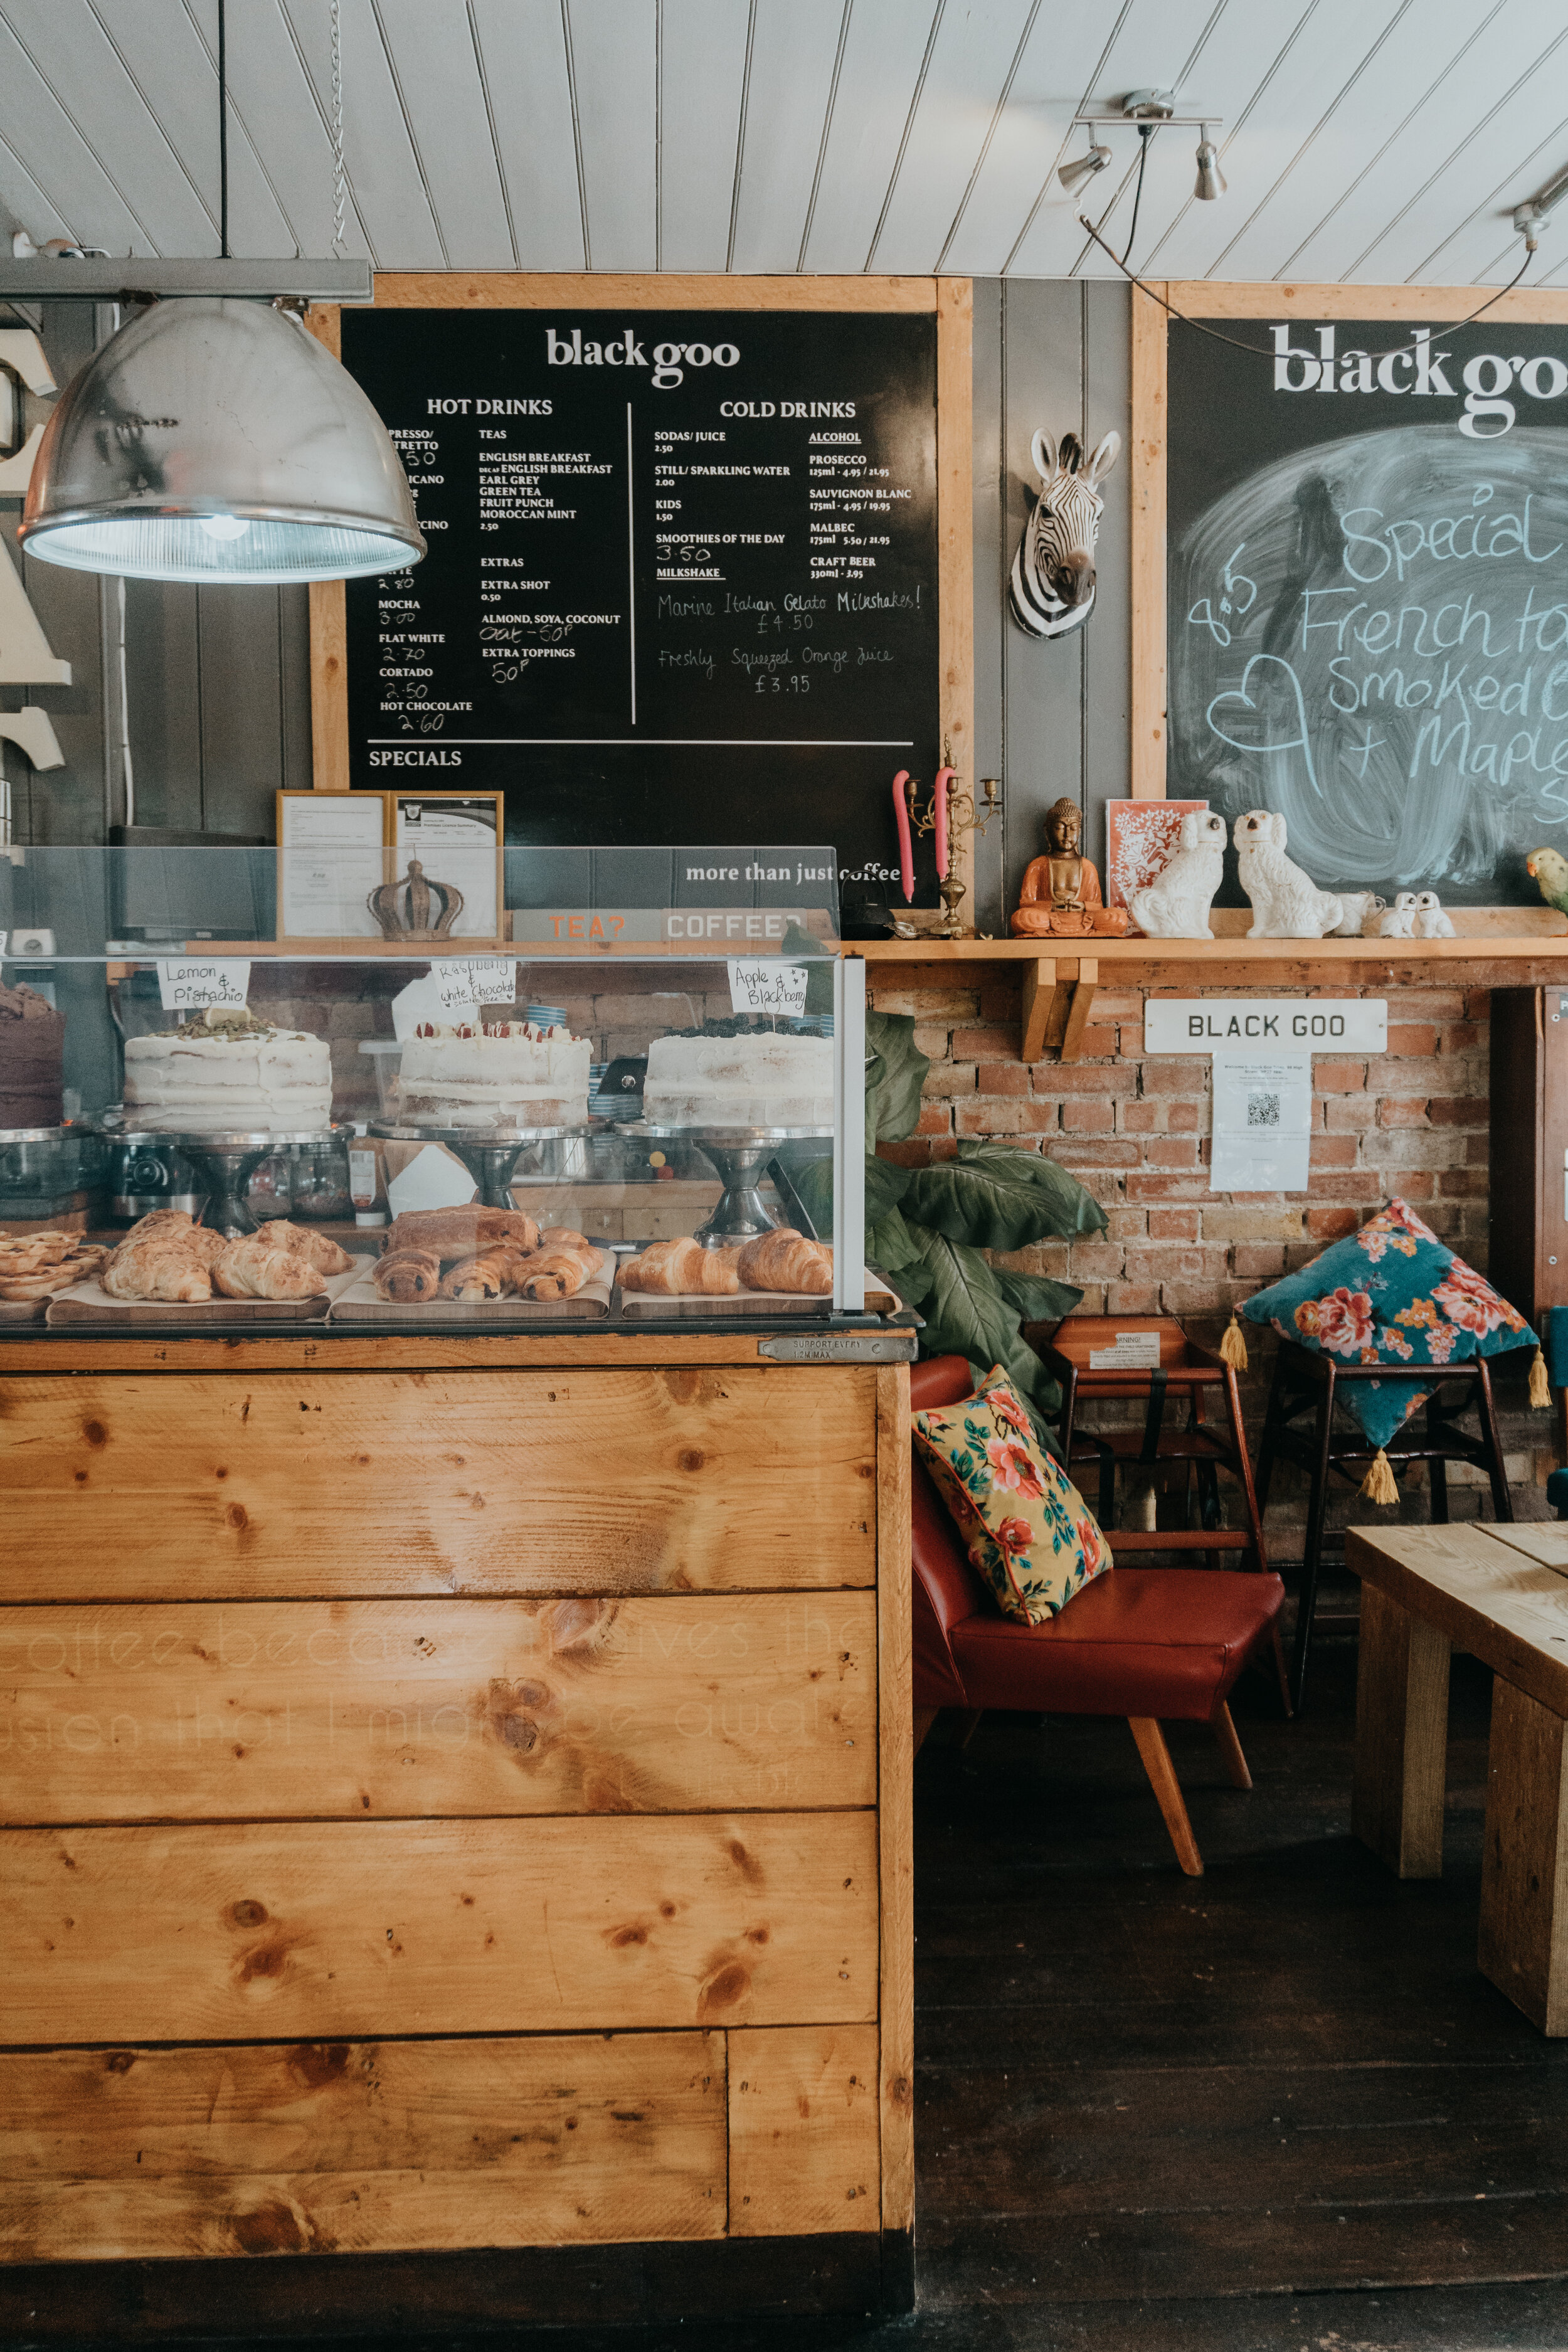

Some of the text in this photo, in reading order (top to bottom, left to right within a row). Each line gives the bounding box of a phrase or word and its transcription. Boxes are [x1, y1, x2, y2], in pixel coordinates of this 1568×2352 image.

[545, 329, 740, 389] black goo
[1268, 323, 1568, 438] black go
[427, 400, 553, 415] HOT DRINKS
[720, 401, 856, 418] COLD DRINKS
[389, 430, 434, 439] PRESSO/
[479, 430, 506, 438] TEAS
[655, 432, 726, 442] SODAS/ JUICE
[808, 432, 862, 442] ALCOHOL
[394, 441, 438, 450] TRETTO
[480, 453, 591, 462] ENGLISH BREAKFAST
[810, 455, 866, 464] PROSECCO
[502, 465, 548, 473] ENGLISH
[551, 465, 612, 474] BREAKFAST
[655, 466, 790, 475] STILL/ SPARKLING WATER
[810, 467, 835, 477] 125ml
[843, 469, 861, 477] 4.95
[869, 469, 889, 477] 21.95
[409, 475, 445, 484] ICANO
[480, 476, 539, 484] EARL GREY
[480, 487, 541, 495] GREEN TEA
[810, 489, 911, 498] SAUVIGNON BLANC
[480, 499, 553, 507] FRUIT PUNCH
[656, 501, 681, 509] KIDS
[810, 501, 835, 511] 175ml
[843, 503, 861, 511] 4.95
[869, 502, 890, 511] 19.95
[480, 510, 576, 519] MOROCCAN MINT
[810, 523, 855, 532] MALBEC
[1340, 483, 1563, 583] Special
[656, 534, 785, 543] SMOOTHIES OF THE DAY
[810, 535, 835, 545] 175ml
[844, 537, 862, 545] 5.50
[655, 544, 712, 561] 3.50
[481, 558, 524, 566] EXTRAS
[810, 557, 876, 566] CRAFT BEER
[656, 568, 721, 578] MILKSHAKE
[811, 569, 838, 579] 330ml
[846, 570, 863, 578] 3.95
[482, 581, 518, 589] EXTRA
[379, 600, 420, 608] MOCHA
[723, 593, 776, 614] Italian
[783, 593, 827, 615] Gelato
[837, 585, 921, 612] Milkshakes!
[379, 611, 416, 624] 3.00
[482, 615, 620, 624] ALMOND, SOYA, COCONUT
[1301, 586, 1510, 657] French
[379, 634, 445, 642] FLAT WHITE
[383, 647, 425, 662] 2.70
[483, 649, 575, 657] EXTRA TOPPINGS
[658, 647, 894, 680] Freshly Squeezed Orange Juice
[755, 675, 810, 693] £3.95
[384, 682, 428, 699] 2.50
[1328, 656, 1532, 726] Smoked
[398, 713, 445, 732] 2.60
[369, 751, 462, 766] SPECIALS
[685, 867, 740, 881] more
[744, 861, 792, 881] than
[795, 861, 834, 886] just
[549, 916, 625, 938] TEA?
[166, 963, 216, 981] Lemon
[736, 967, 768, 989] Apple
[748, 988, 805, 1010] Blackberry
[1189, 1015, 1345, 1037] BLACK GOO
